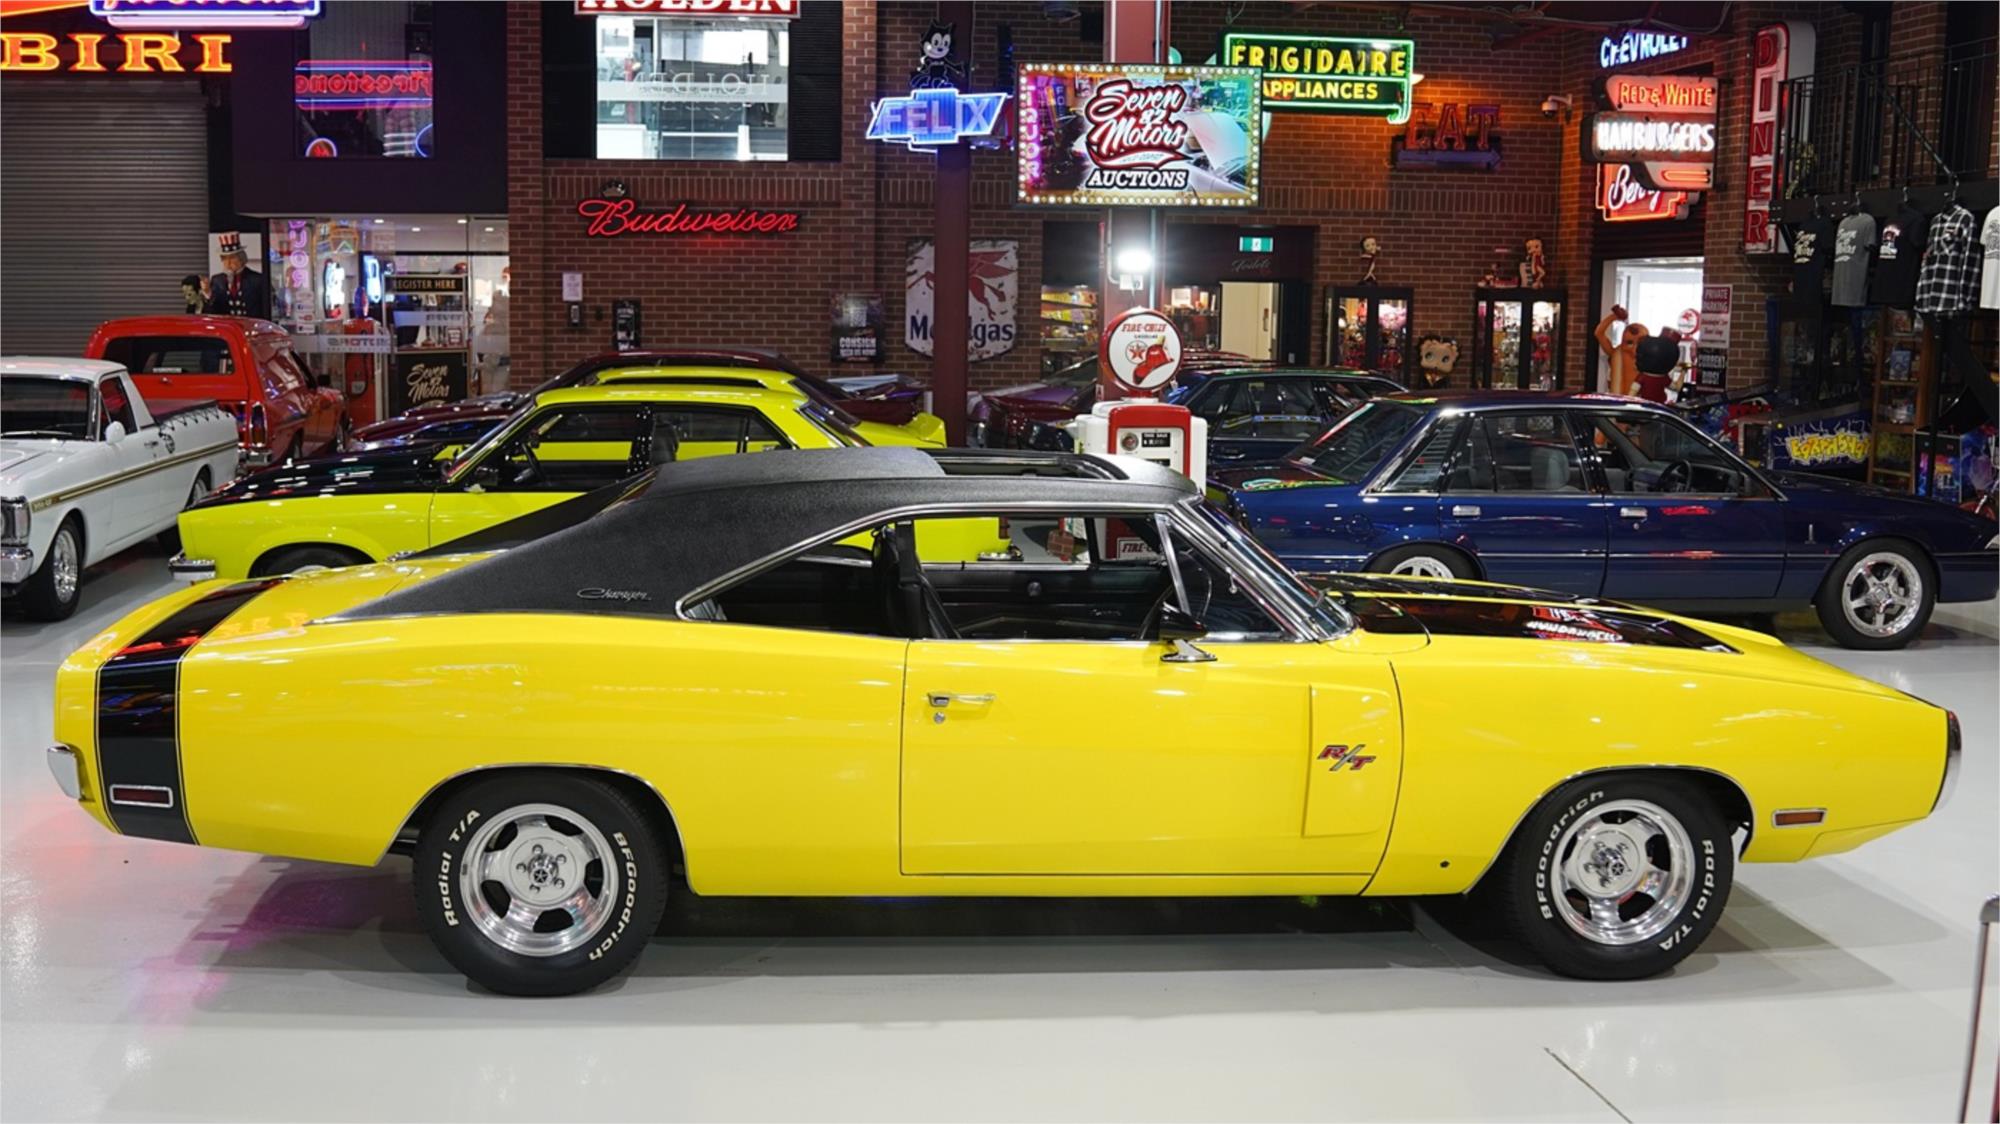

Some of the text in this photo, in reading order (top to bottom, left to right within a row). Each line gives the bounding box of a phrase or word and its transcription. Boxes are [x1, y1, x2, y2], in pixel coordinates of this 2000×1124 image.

[1232, 45, 1406, 76] FRIGIDAIRE
[1090, 82, 1183, 119] Seven
[1620, 83, 1647, 103] RED
[1664, 83, 1713, 106] WHITE
[884, 97, 991, 135] FELIX
[1141, 110, 1166, 125] 82
[1404, 102, 1500, 150] EAT
[1091, 118, 1185, 155] Motors
[1597, 121, 1716, 152] HAMBURGERS
[1747, 31, 1779, 243] DINER
[1088, 171, 1187, 187] AUCTIONS
[578, 199, 799, 237] Budweiser
[435, 280, 456, 289] HERE
[407, 363, 448, 386] Seven
[576, 587, 652, 602] Charger
[1317, 744, 1376, 771] R/T
[438, 810, 481, 926] Radial T/A
[1535, 790, 1604, 920] BFGoodrich
[589, 832, 637, 961] BFGoodrich
[1659, 840, 1715, 951] Radial T/A
